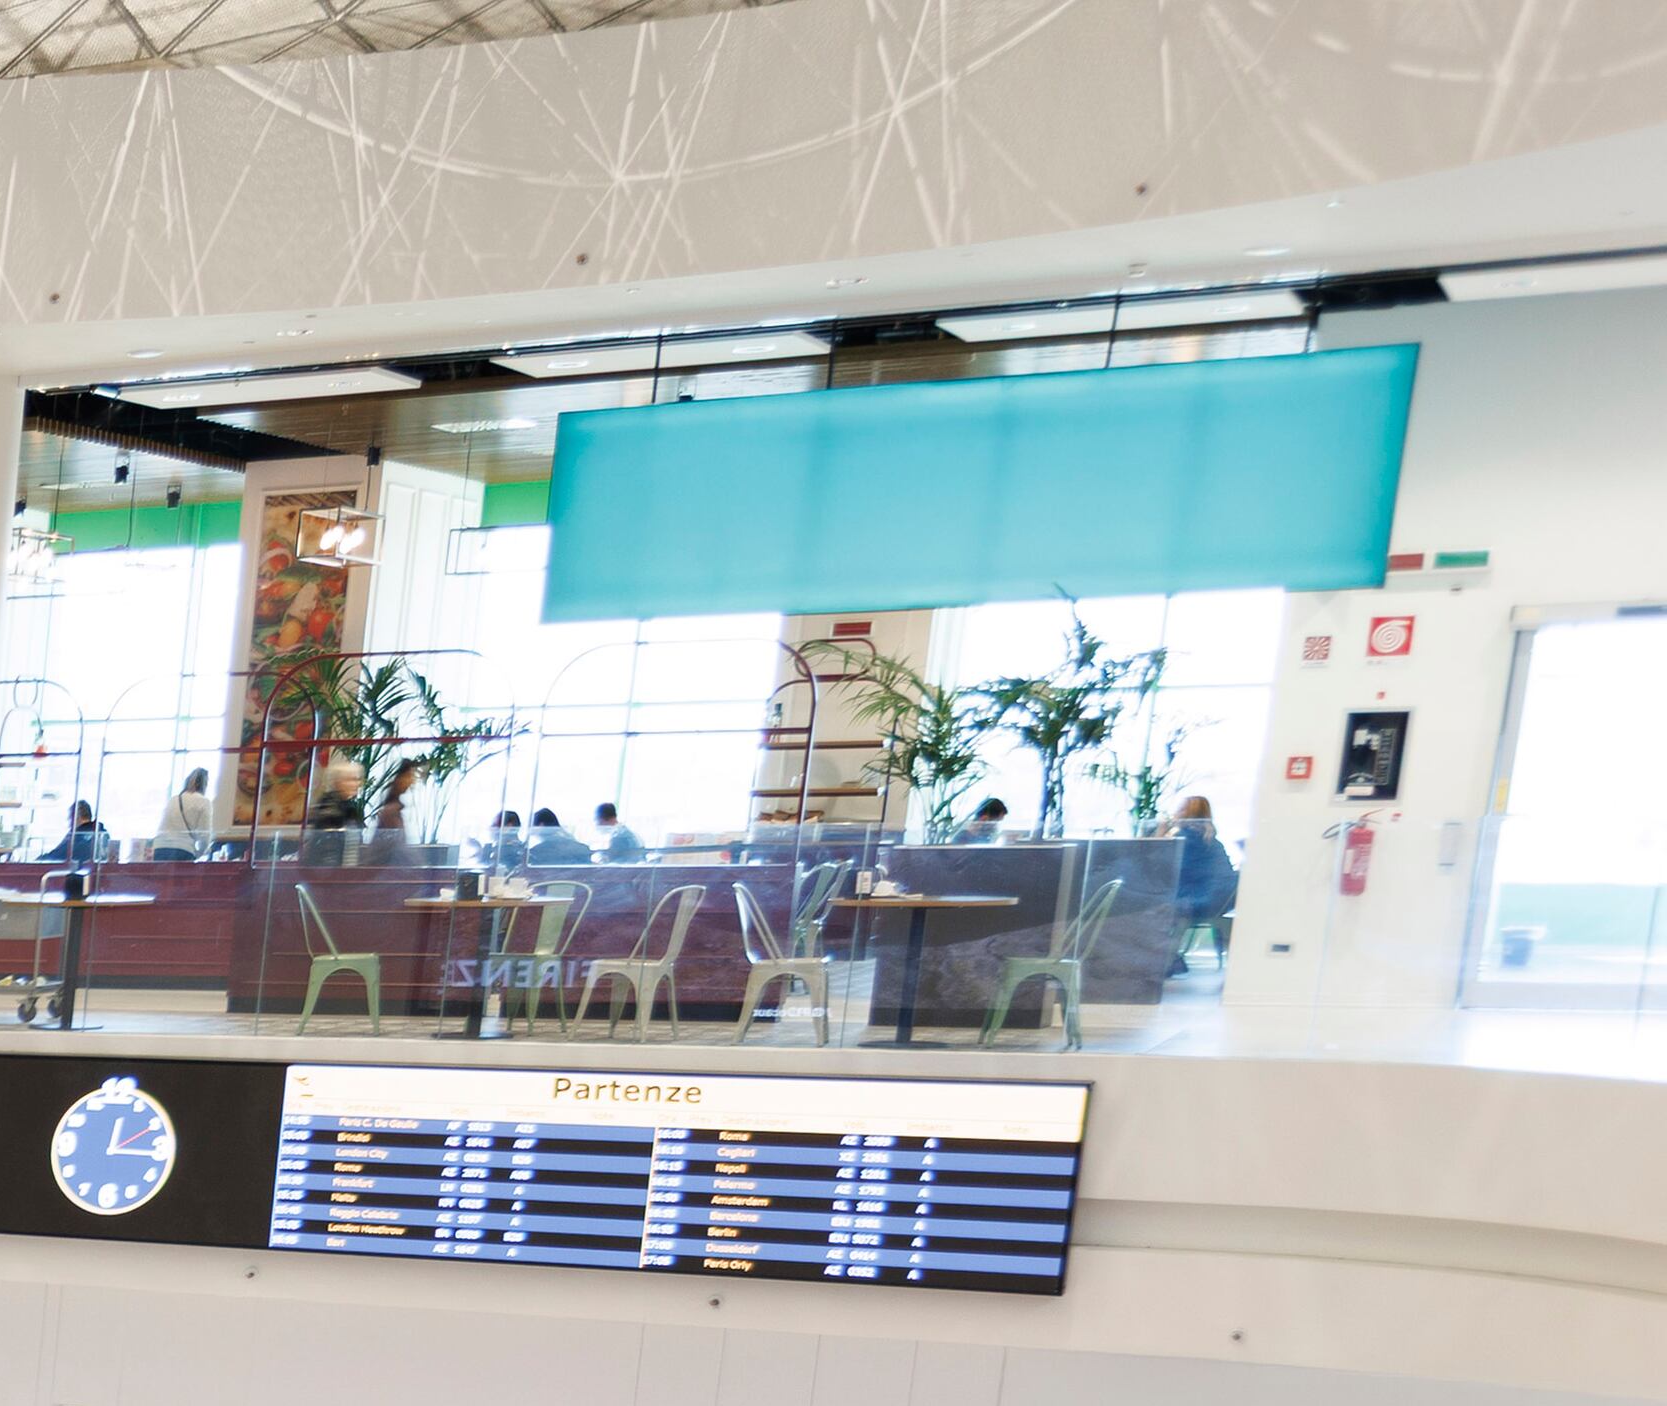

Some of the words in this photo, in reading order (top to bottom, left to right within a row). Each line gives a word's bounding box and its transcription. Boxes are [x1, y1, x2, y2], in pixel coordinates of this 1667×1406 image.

[553, 1077, 703, 1105] Partenze
[98, 1183, 118, 1208] 6
[711, 1195, 769, 1206] Amsterdam
[704, 1259, 729, 1269] Paris
